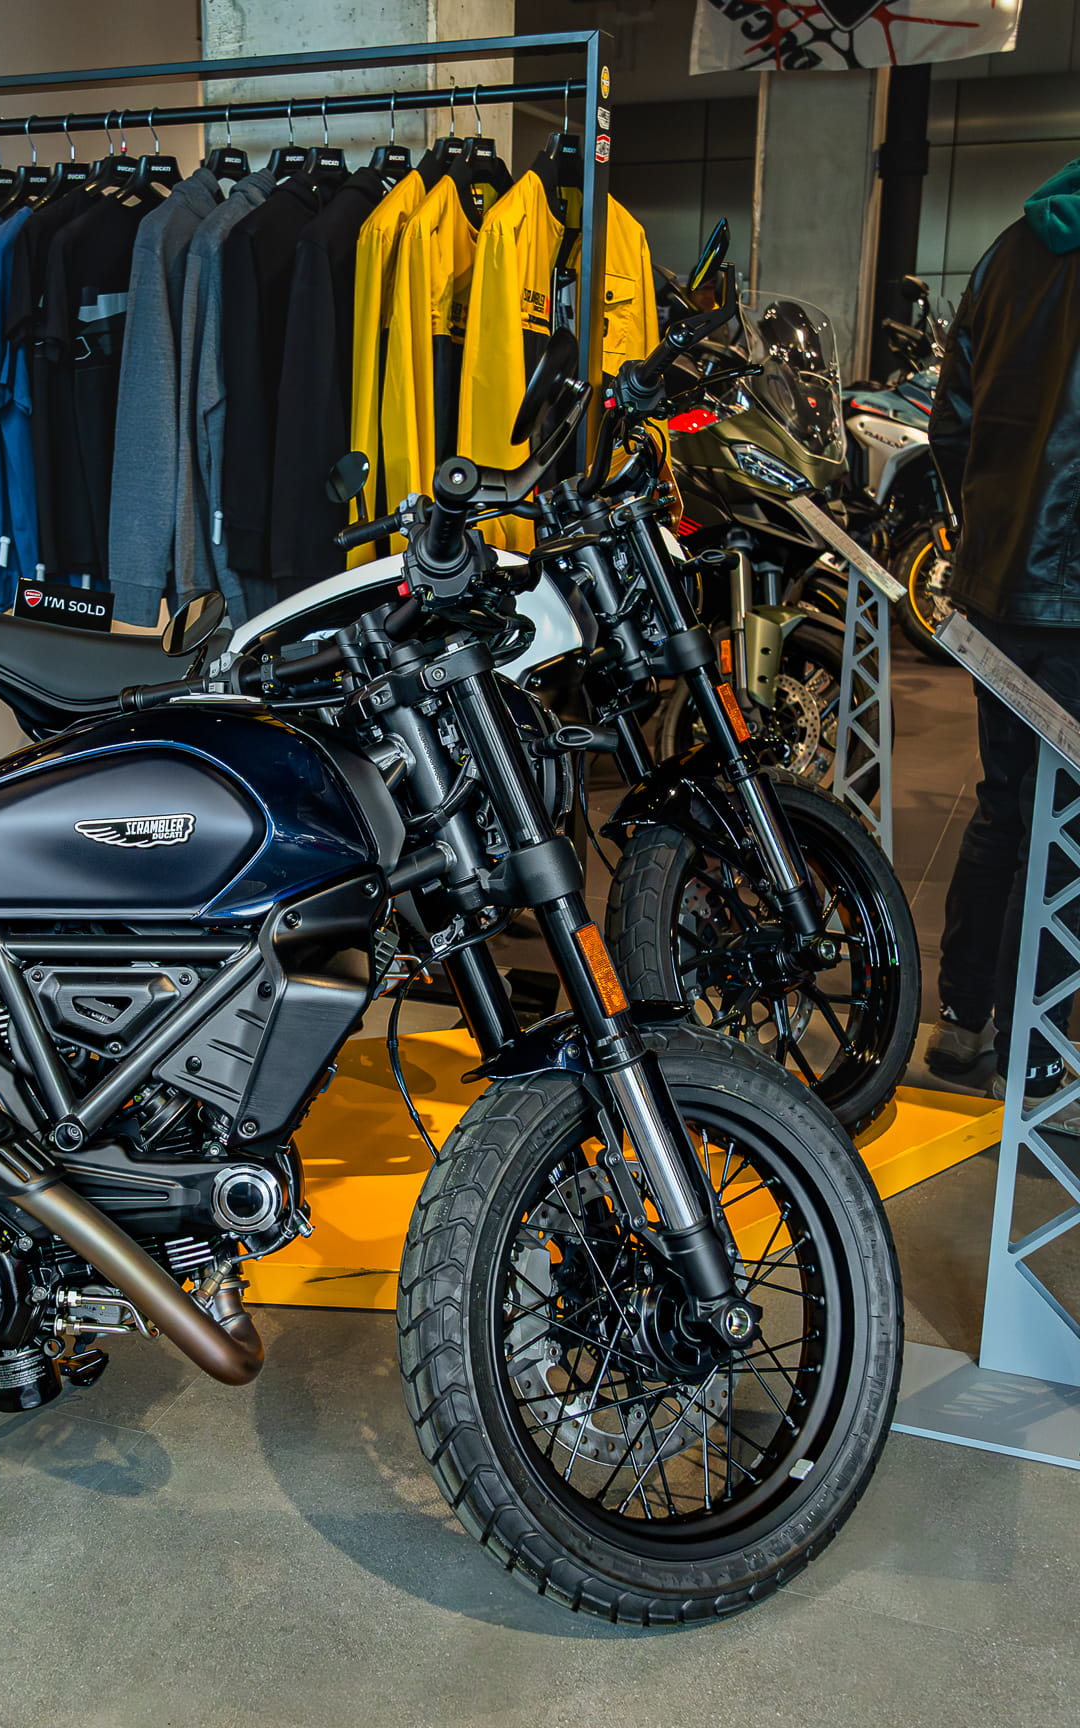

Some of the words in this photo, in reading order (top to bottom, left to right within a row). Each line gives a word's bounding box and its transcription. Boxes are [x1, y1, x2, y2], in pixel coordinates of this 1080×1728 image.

[43, 596, 65, 610] I'M
[68, 600, 106, 616] SOLD
[125, 818, 185, 835] SCRAMBLER
[152, 831, 183, 840] DUCATI
